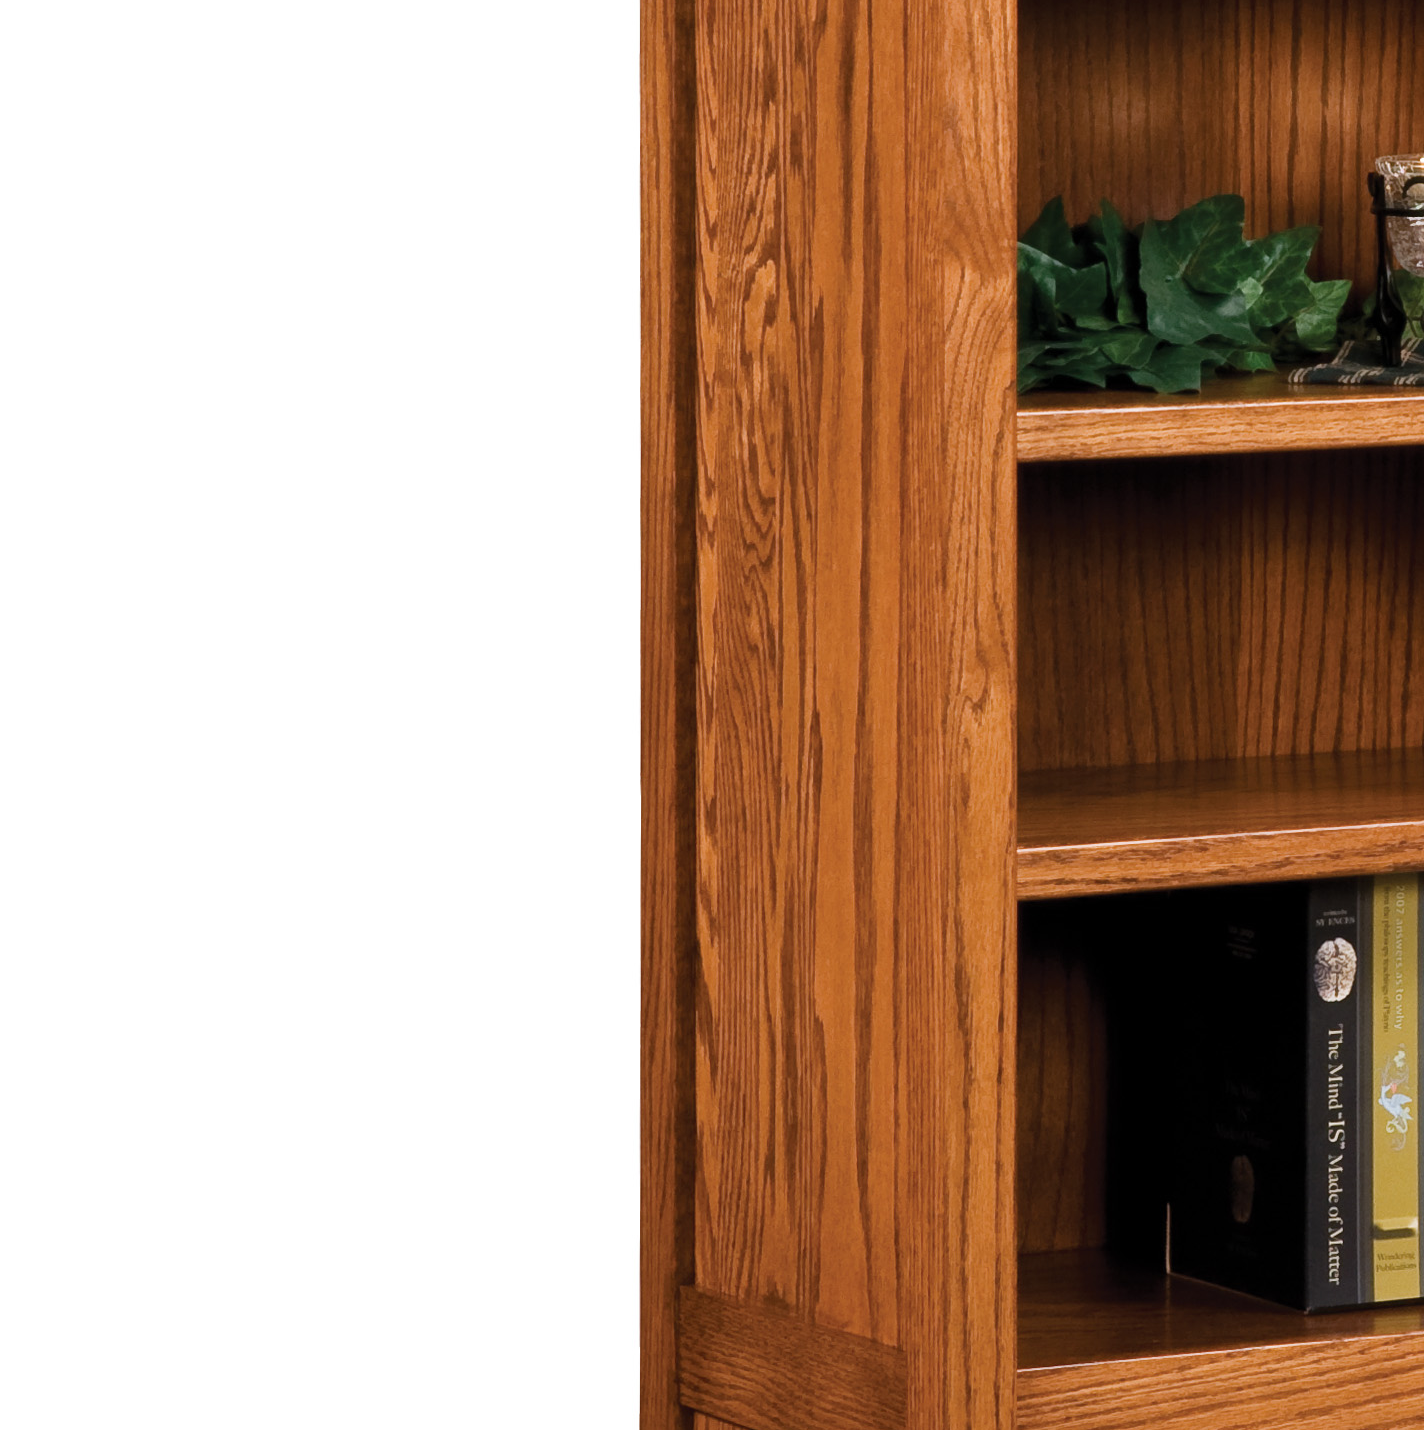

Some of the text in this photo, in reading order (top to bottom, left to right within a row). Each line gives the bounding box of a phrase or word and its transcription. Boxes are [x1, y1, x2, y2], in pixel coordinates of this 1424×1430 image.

[1393, 884, 1405, 1031] 2007 answers as to why
[1328, 1023, 1344, 1060] The
[1328, 1063, 1344, 1112] Mind
[1327, 1154, 1344, 1203] Made
[1327, 1206, 1344, 1227] of
[1327, 1227, 1344, 1286] Matter
